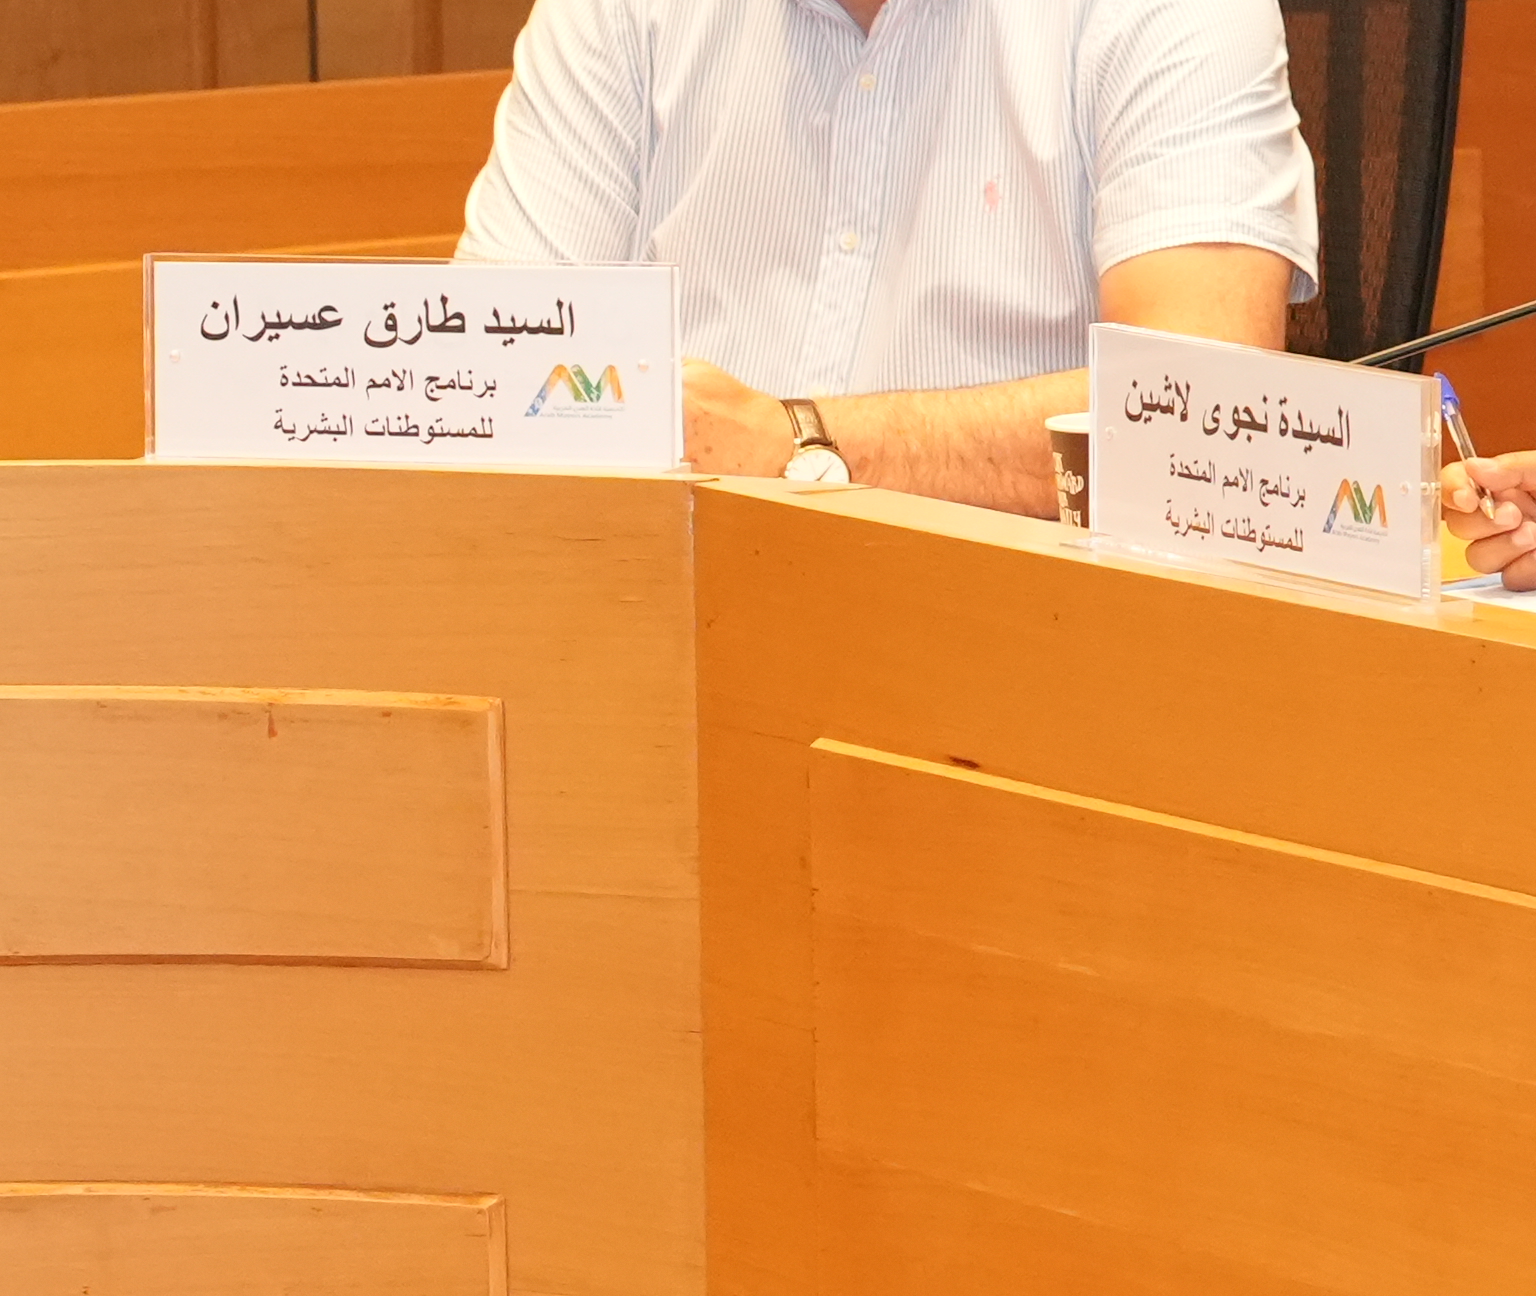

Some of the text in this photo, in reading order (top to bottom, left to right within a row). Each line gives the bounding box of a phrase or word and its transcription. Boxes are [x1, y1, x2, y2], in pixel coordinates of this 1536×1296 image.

[200, 293, 575, 349] السيد طارق عسيران
[279, 365, 497, 402] برنامج الامم المتحدة
[273, 408, 494, 445] للمستوطنات البشرية
[1124, 374, 1351, 455] السيدة نجوى لاشين
[1169, 453, 1306, 508] برنامج الامم المتحدة
[1165, 499, 1304, 553] للمستوطنات البشرية
